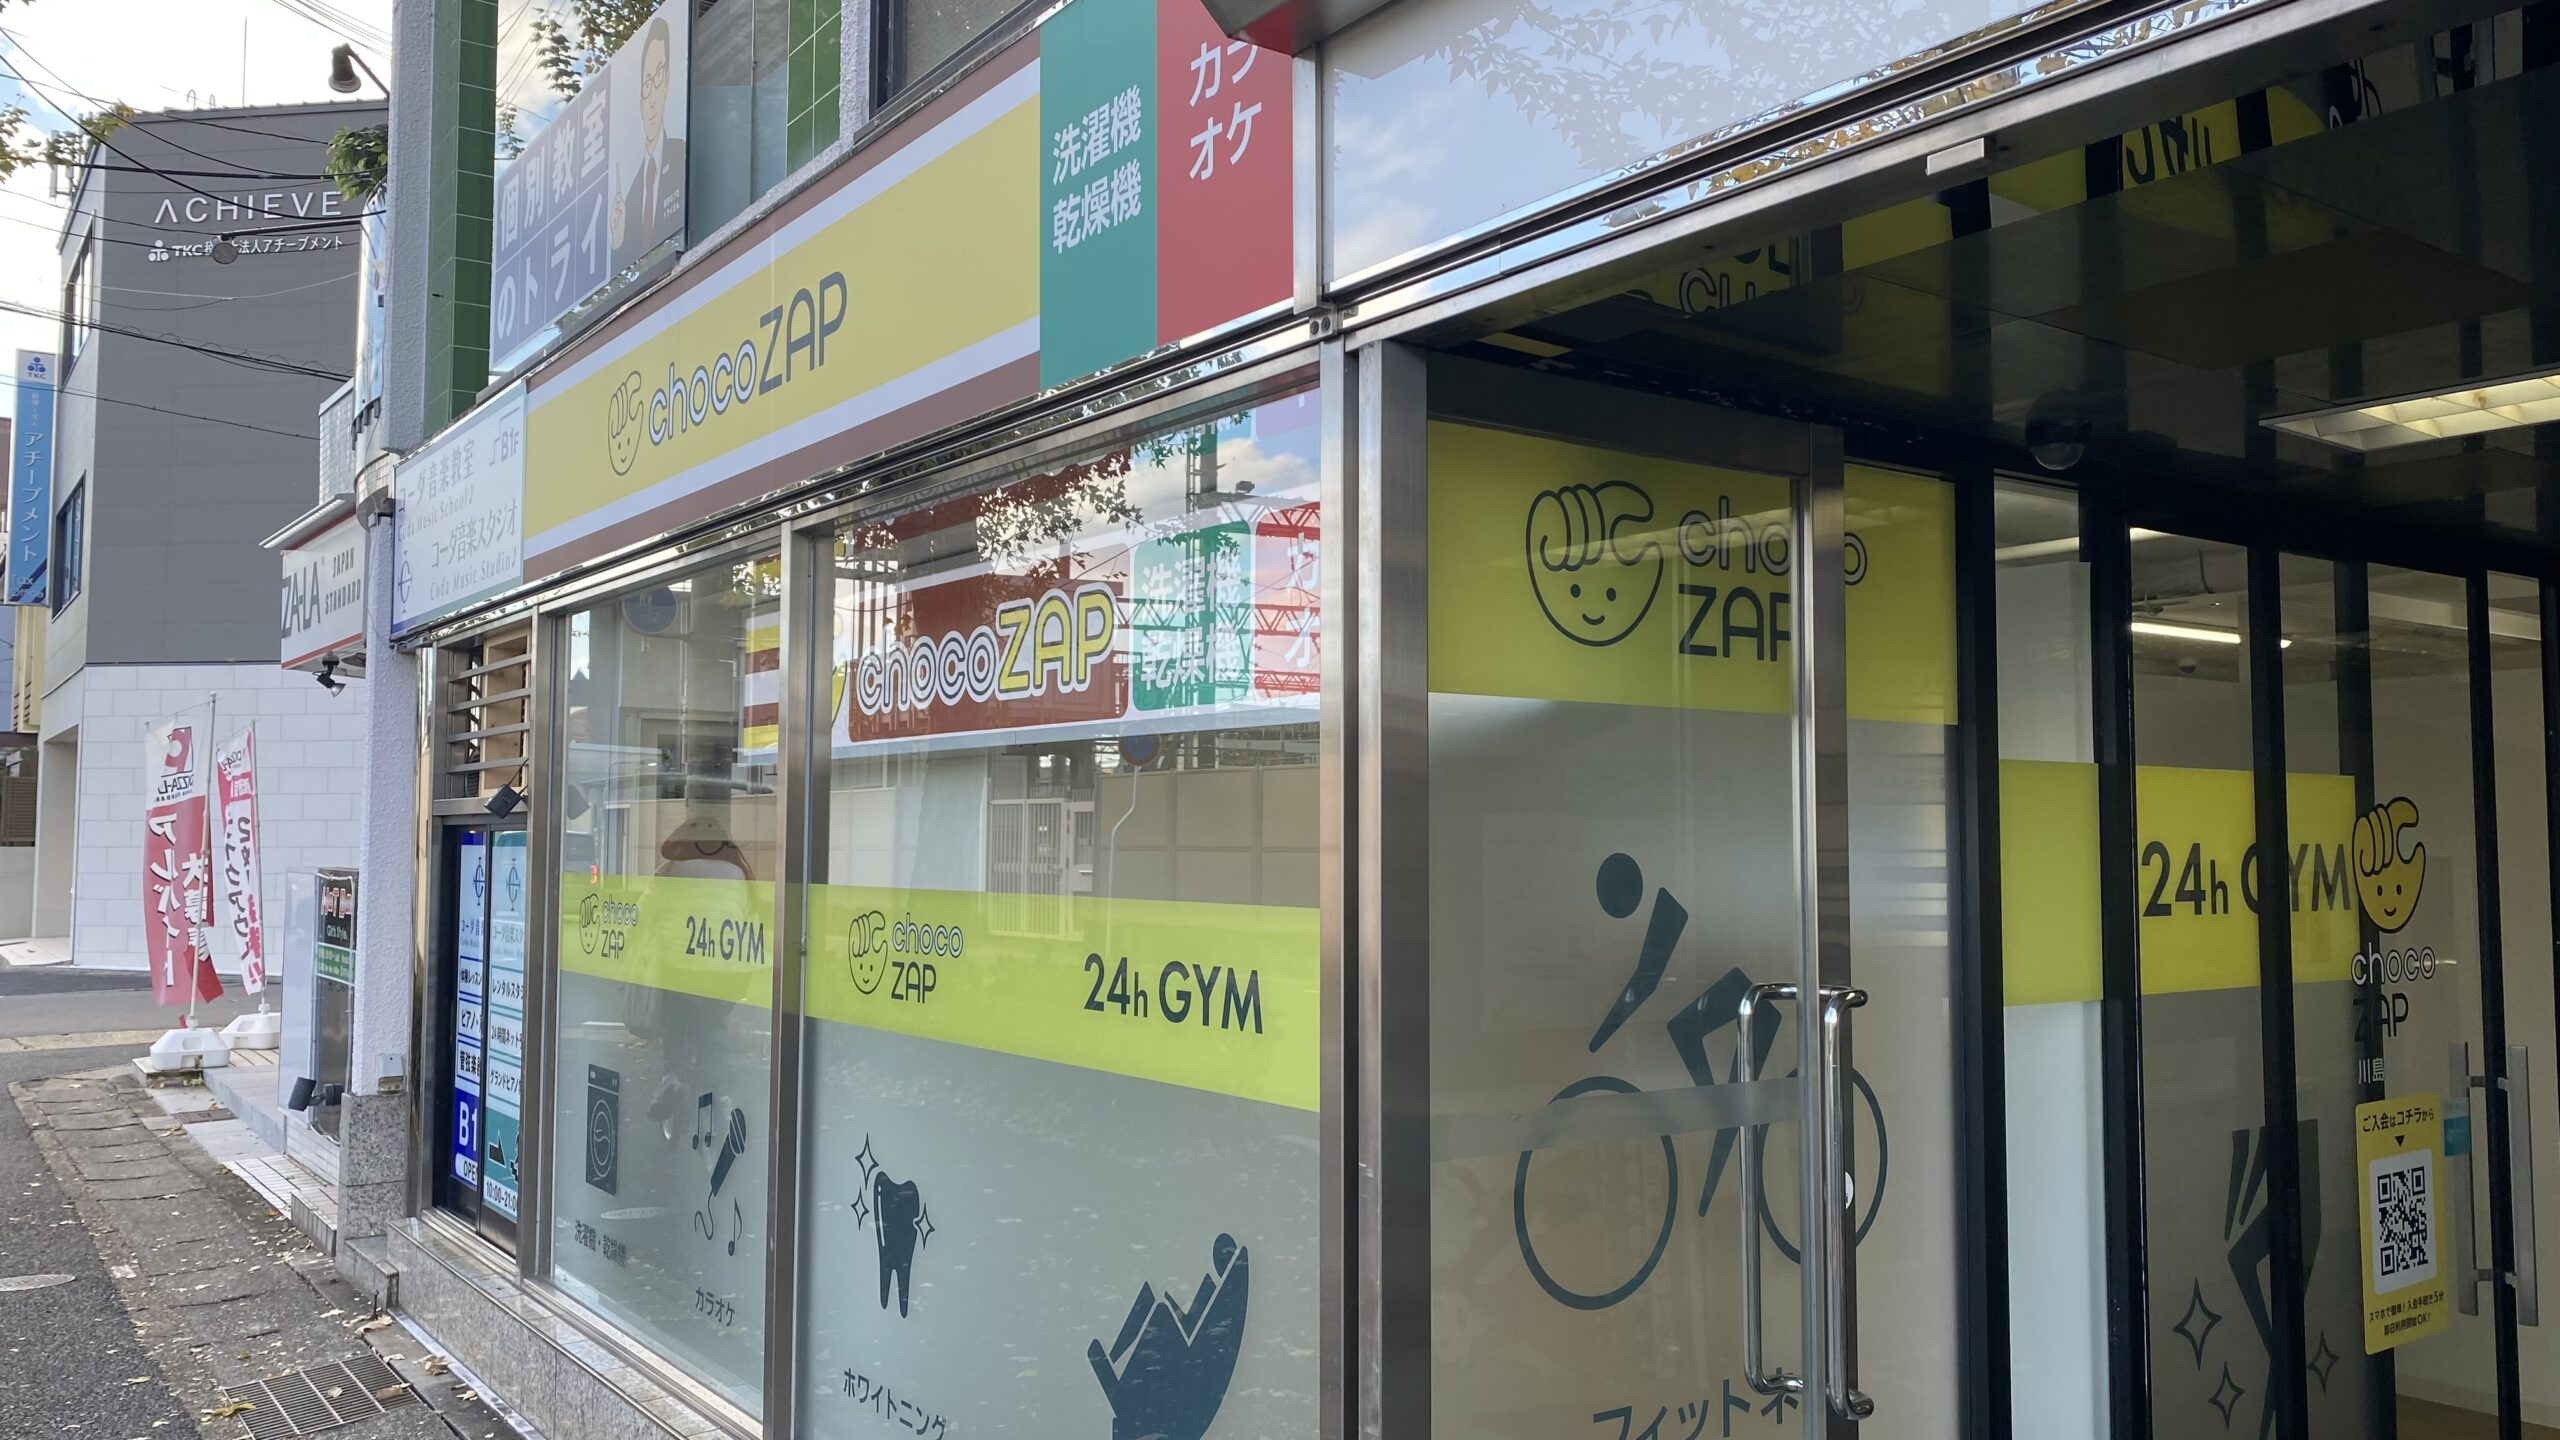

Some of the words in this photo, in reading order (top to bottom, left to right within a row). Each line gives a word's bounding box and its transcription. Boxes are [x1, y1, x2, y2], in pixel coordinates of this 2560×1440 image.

[1053, 84, 1142, 186] 洗濯機
[1189, 101, 1262, 181] オケ
[499, 88, 606, 252] 個別教室
[154, 190, 342, 224] ACHIEVE
[1053, 158, 1142, 254] 乾燥機
[172, 243, 203, 257] TKC
[497, 192, 603, 340] のトライ
[27, 372, 46, 380] TKC
[648, 271, 847, 446] chocoZAP
[501, 427, 519, 462] B1F
[21, 431, 44, 562] アチーブメント
[398, 438, 475, 513] コーダ音楽教室
[417, 508, 438, 532] Music
[440, 485, 467, 520] School
[431, 497, 518, 569] コーダ音楽スタジオ
[332, 546, 354, 578] JAPAN
[1677, 495, 1868, 586] choo
[11, 574, 34, 585] Tax
[325, 578, 360, 615] STANDARD
[430, 576, 449, 600] Coda
[453, 566, 477, 590] Music
[481, 551, 511, 580] Studio
[1141, 549, 1241, 618] 洗濯機
[858, 586, 1117, 715] chocoZAP
[1140, 620, 1241, 690] 乾燥機
[2141, 840, 2229, 918] 24h
[602, 893, 639, 927] choco
[891, 911, 964, 959] choco
[601, 929, 625, 960] ZAP
[685, 915, 715, 958] 24h
[719, 918, 765, 965] GYM
[2350, 941, 2436, 986] choco
[890, 960, 937, 1005] ZAP
[1084, 952, 1149, 1019] 24h
[1158, 959, 1264, 1035] GYM
[459, 1100, 478, 1152] B1
[2362, 1107, 2435, 1133] ご入会はコチラから
[695, 1285, 736, 1327] カラオケ
[842, 1367, 948, 1440] ホワイトニング
